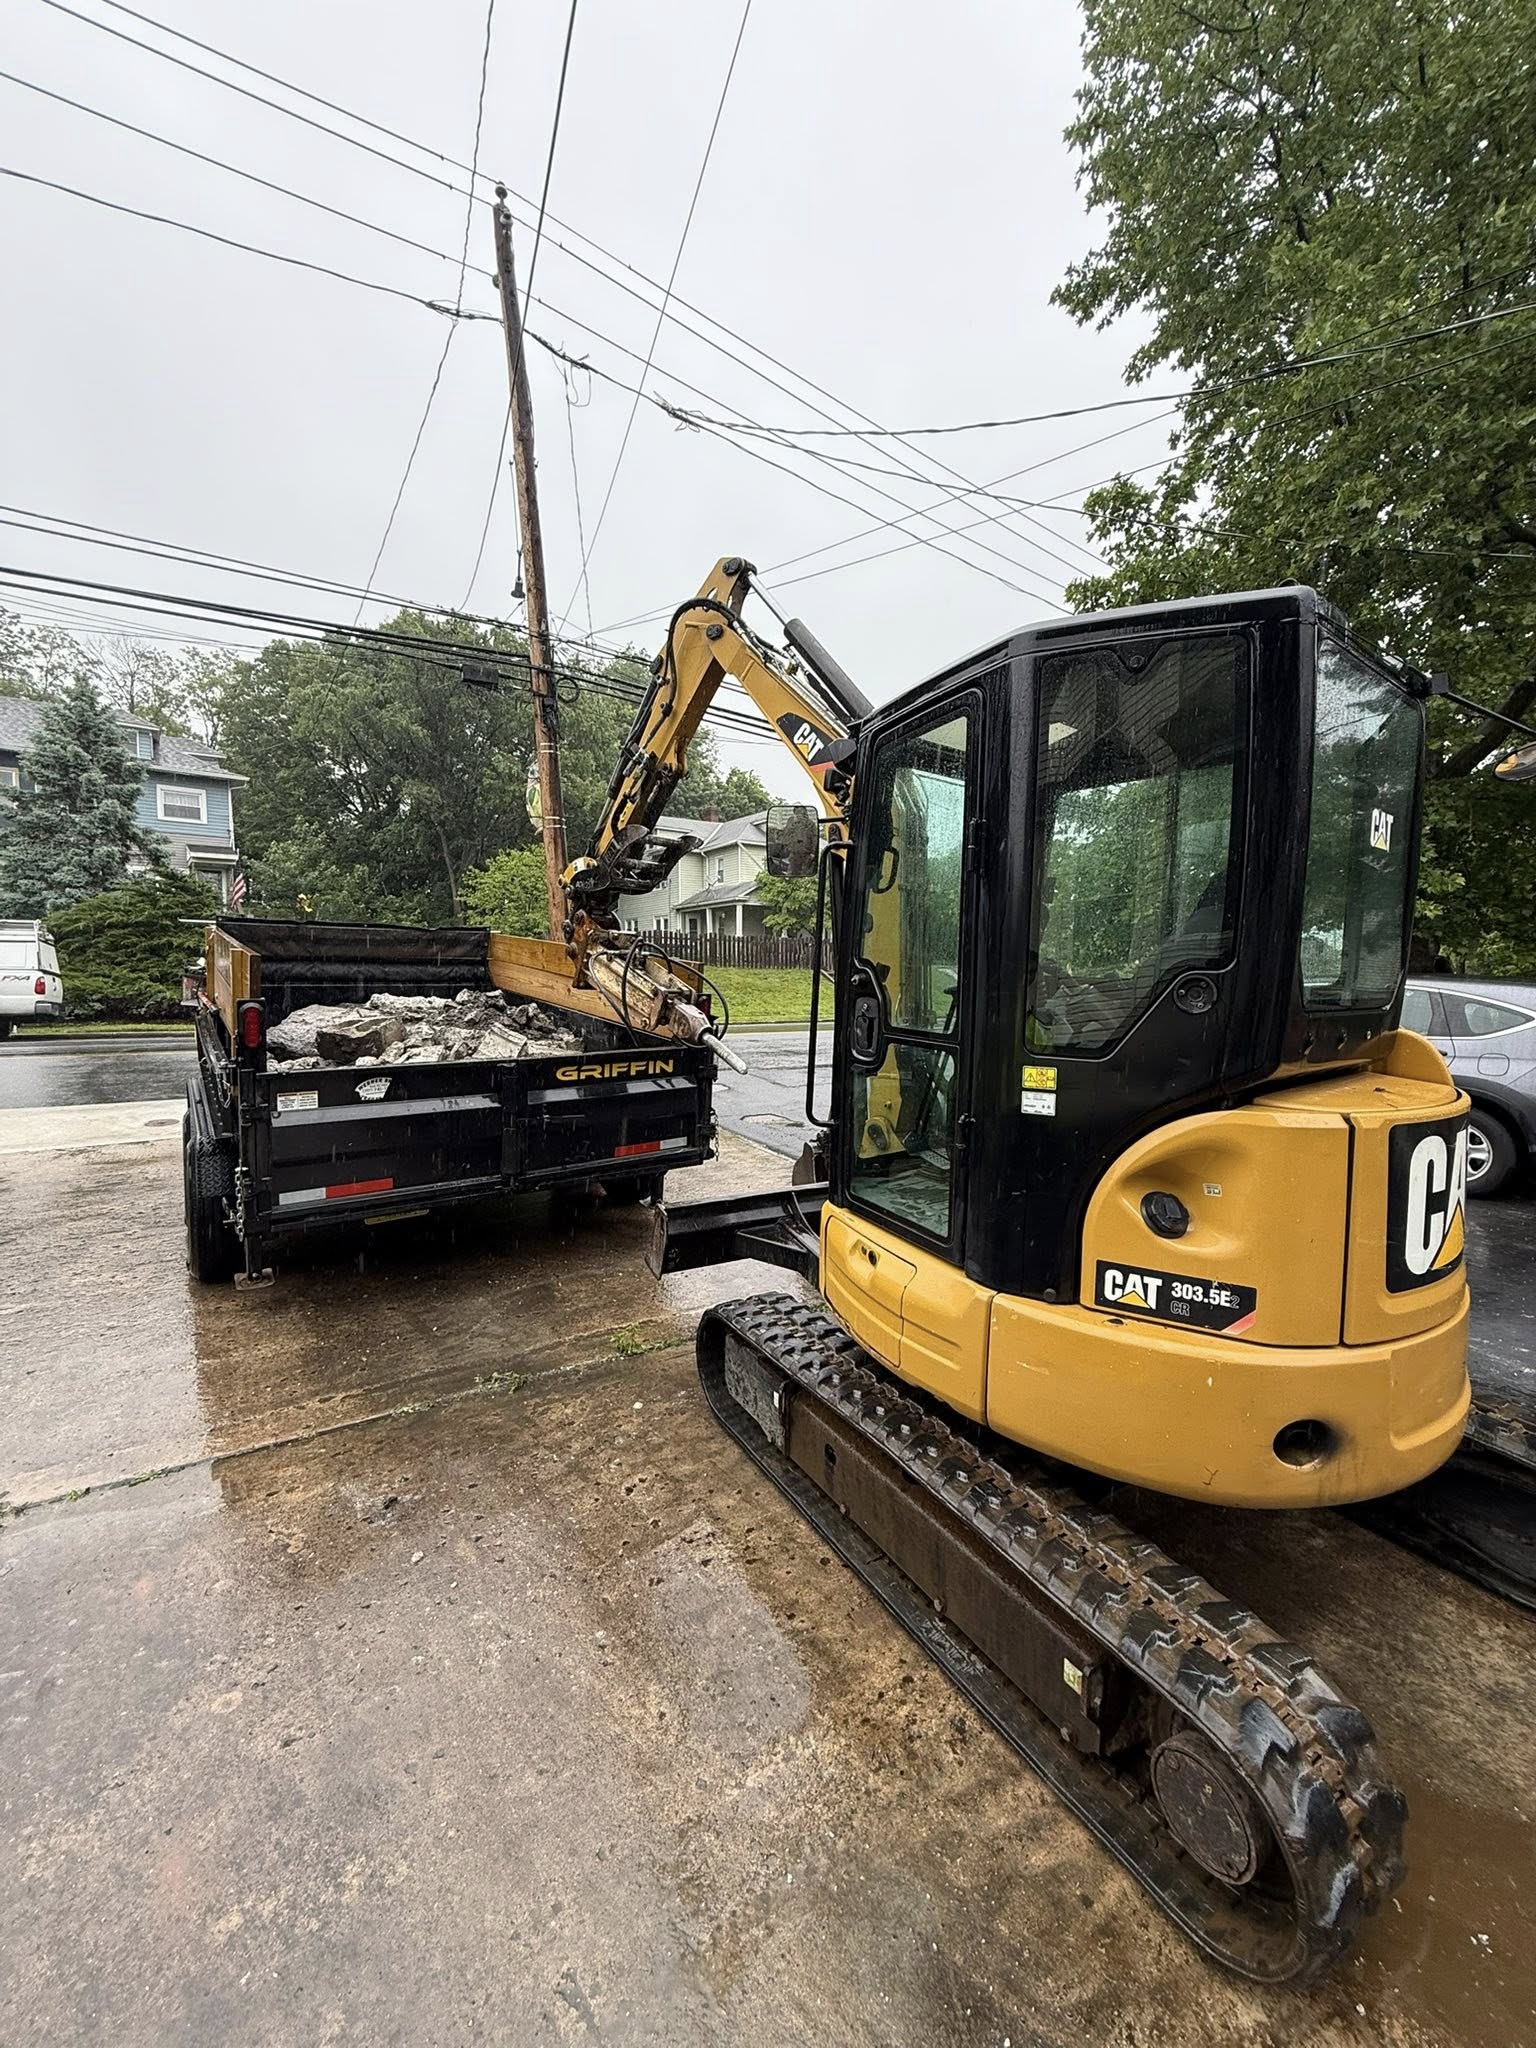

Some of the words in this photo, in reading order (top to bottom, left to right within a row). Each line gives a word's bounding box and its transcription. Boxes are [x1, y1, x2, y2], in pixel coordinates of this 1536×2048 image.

[793, 722, 825, 762] CAT
[1370, 808, 1394, 853] CAT
[556, 1059, 674, 1081] GRIFFIN
[1104, 1269, 1163, 1310] CAT
[1170, 1300, 1191, 1316] CR
